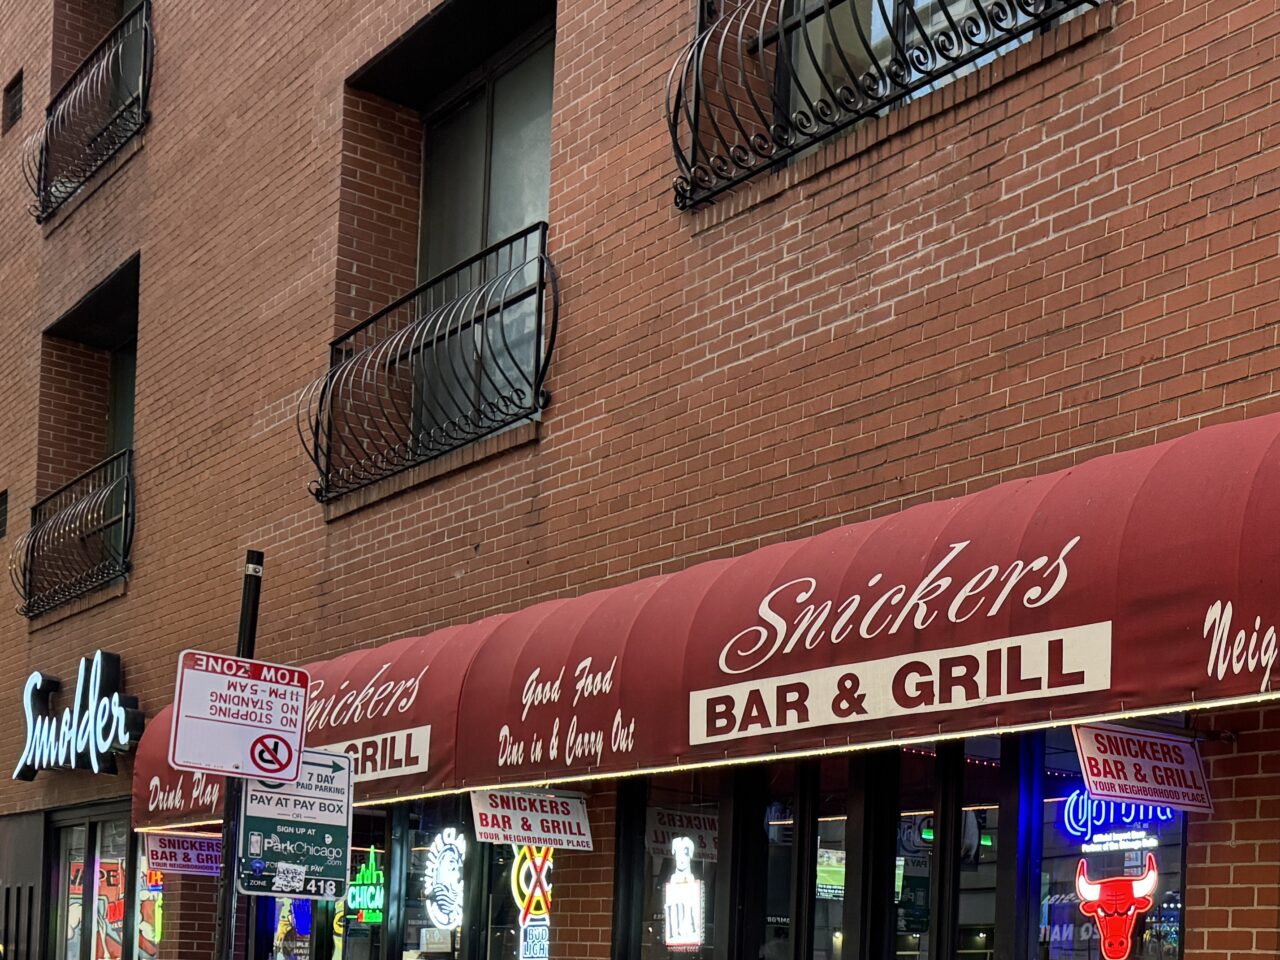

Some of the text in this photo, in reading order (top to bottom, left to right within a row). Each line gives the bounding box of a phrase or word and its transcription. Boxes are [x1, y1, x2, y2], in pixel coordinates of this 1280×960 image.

[717, 535, 1081, 674] Snickers
[194, 655, 300, 686] TOW ZONE
[521, 655, 617, 722] Good Food
[706, 639, 1085, 738] BAR & GRILL
[12, 649, 129, 780] Smolder
[210, 691, 299, 715] NO STANDING
[209, 704, 298, 728] NO STOPPING
[498, 708, 635, 767] Dine in & Carry Out
[1094, 733, 1184, 765] SNICKERS
[307, 772, 336, 785] 7 DAY
[1087, 756, 1202, 790] BAR & GRILL
[190, 771, 219, 814] Play
[296, 782, 345, 795] PAID PARKING
[1093, 780, 1207, 804] YOUR NEIGHBORHOOD PLACE
[250, 794, 344, 814] PAY AT PAY BOX
[489, 793, 570, 815] SNICKERS
[276, 825, 294, 833] SIGN
[479, 813, 586, 836] BAR & GRILL
[159, 838, 222, 852] SNICKERS
[479, 832, 591, 848] YOUR NEIGHBORHOOD PLACE
[151, 850, 220, 864] BAR & GRI
[527, 928, 548, 941] BUD
